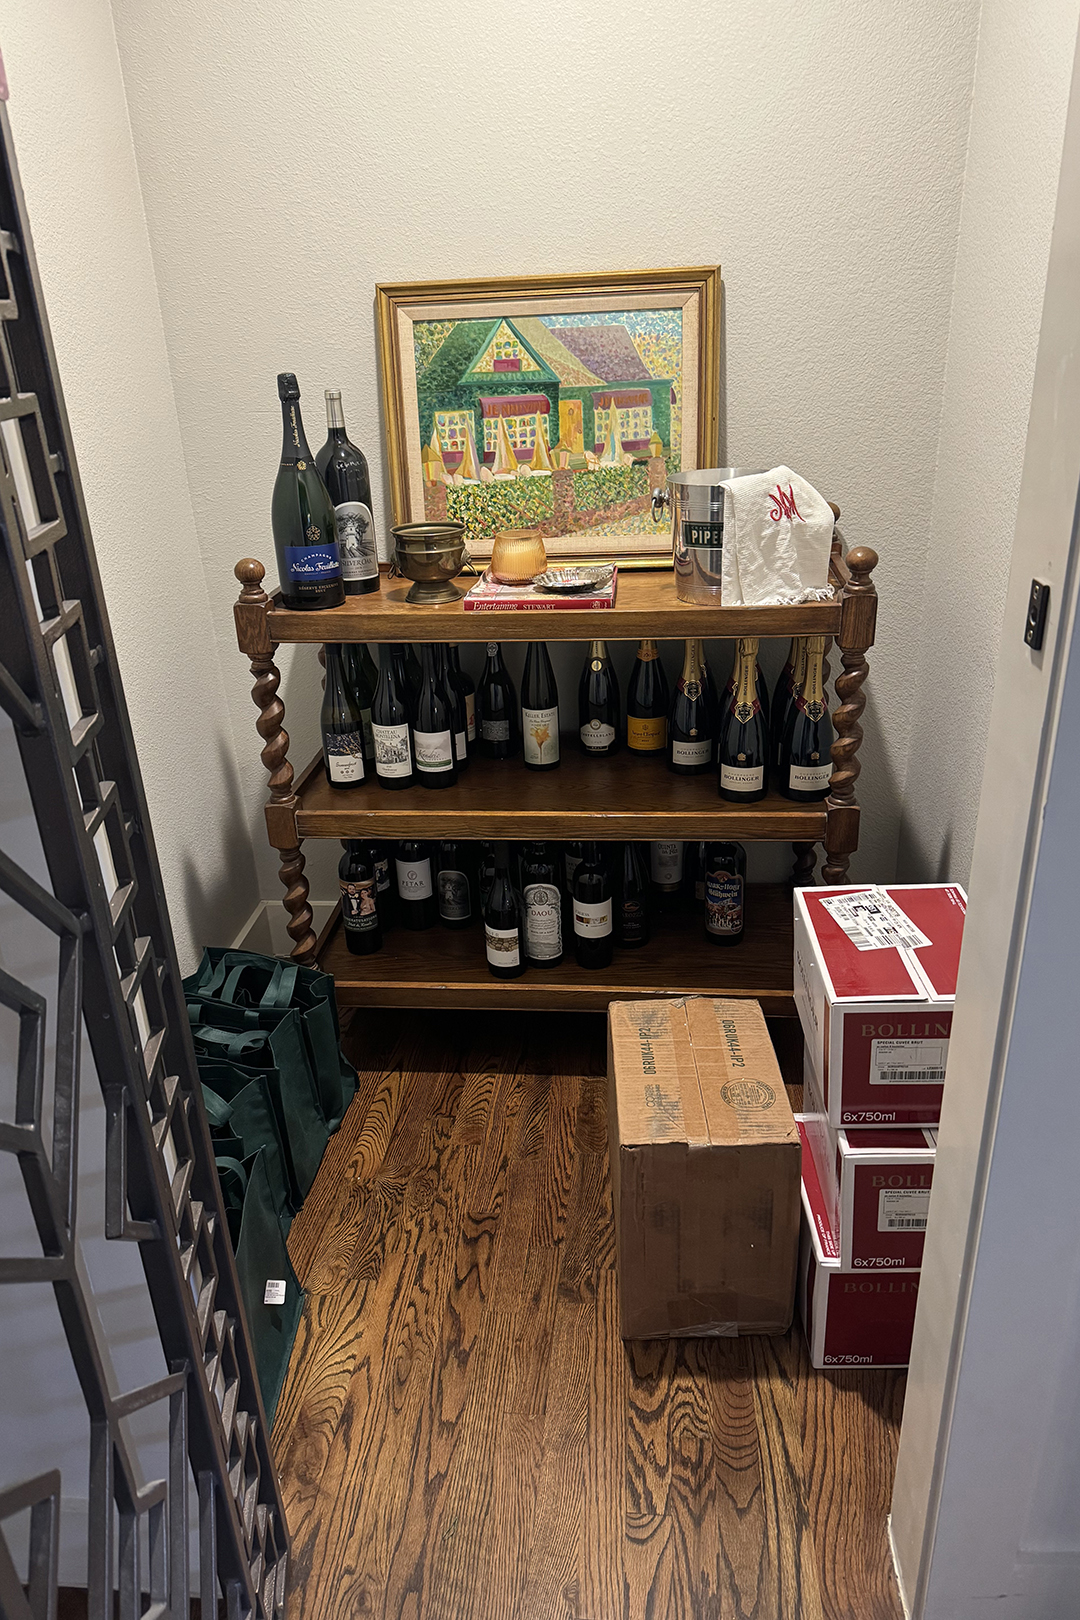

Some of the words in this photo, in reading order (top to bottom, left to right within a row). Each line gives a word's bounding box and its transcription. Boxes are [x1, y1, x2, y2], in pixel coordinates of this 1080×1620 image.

[691, 529, 723, 544] PIPE
[300, 553, 332, 563] CHAMPAGNE
[290, 562, 315, 573] Nicolas
[473, 601, 518, 611] Entertaining
[723, 774, 760, 782] BOLLINGER
[794, 774, 829, 782] BOLLINGER
[861, 1022, 949, 1037] BOLLIN
[843, 1112, 896, 1122] 6x750ml
[871, 1175, 930, 1187] BOLL
[854, 1257, 905, 1267] 6x750ml
[824, 1354, 873, 1364] 6x750ml
